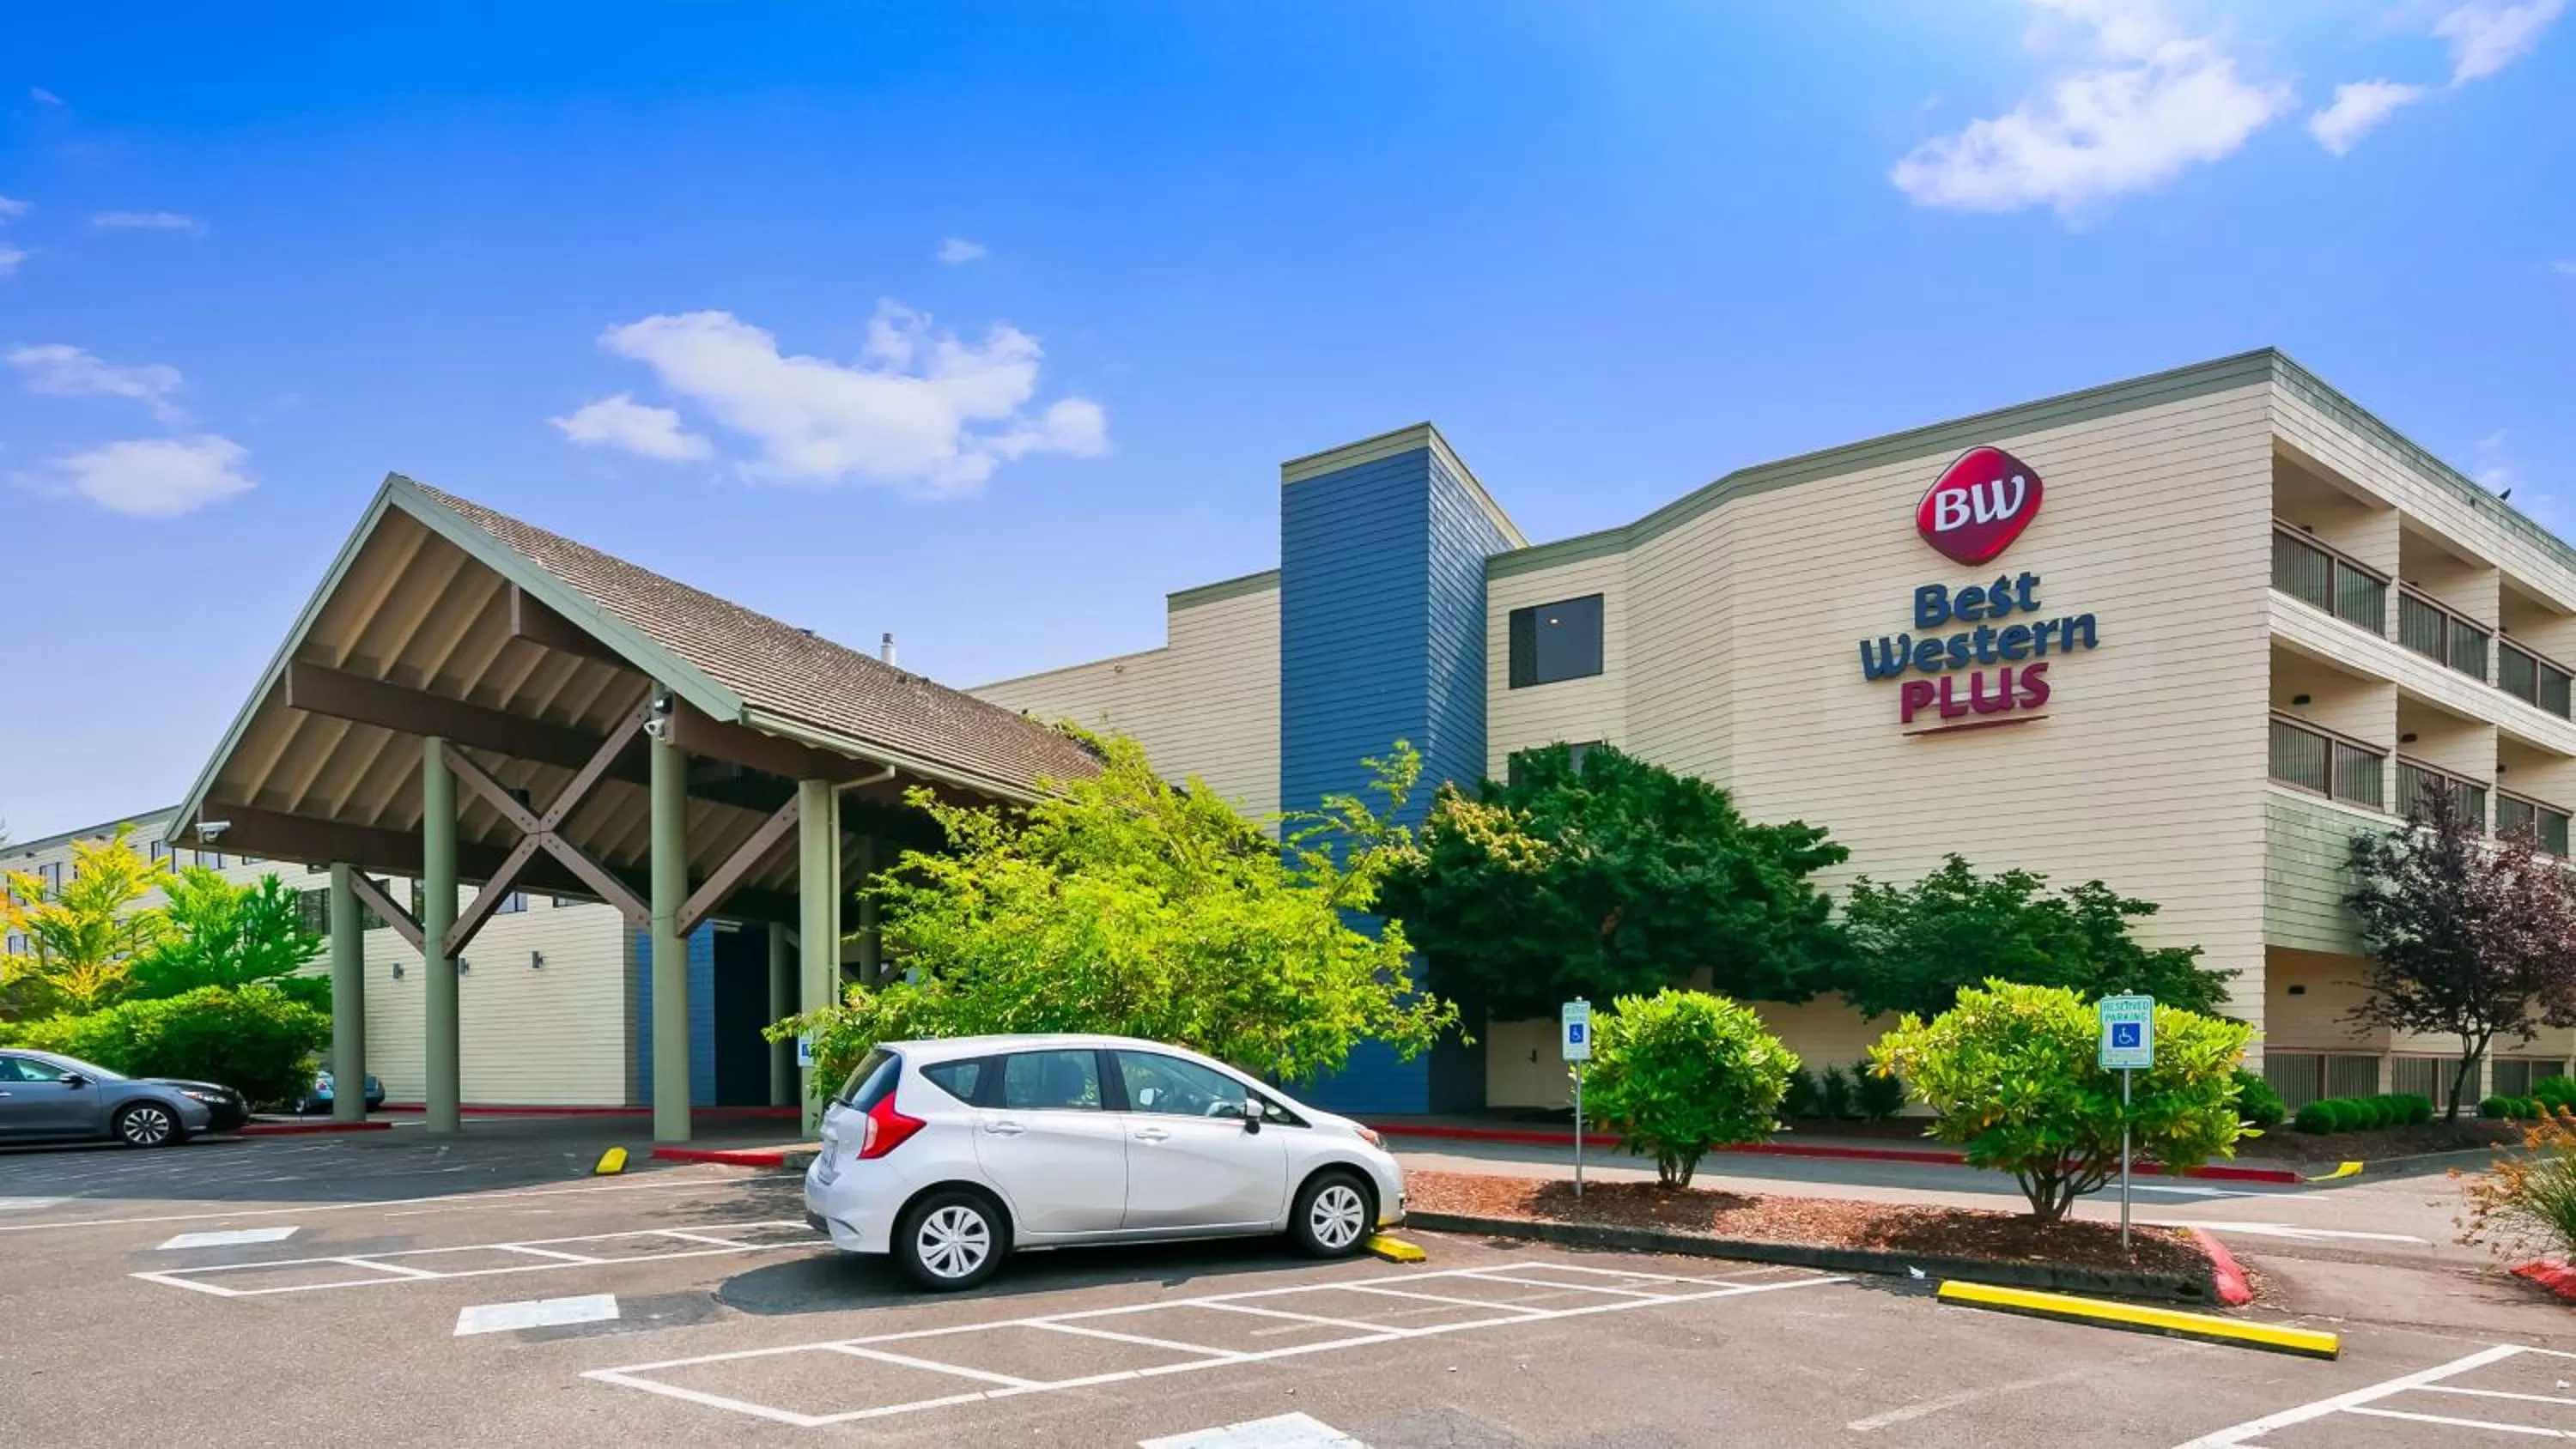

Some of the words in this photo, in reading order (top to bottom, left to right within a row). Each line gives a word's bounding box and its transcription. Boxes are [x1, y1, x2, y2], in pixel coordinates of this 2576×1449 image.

[1935, 476, 2025, 531] BW
[1914, 572, 2041, 628] Best
[1859, 612, 2100, 682] Western
[1899, 662, 2051, 724] PLUS
